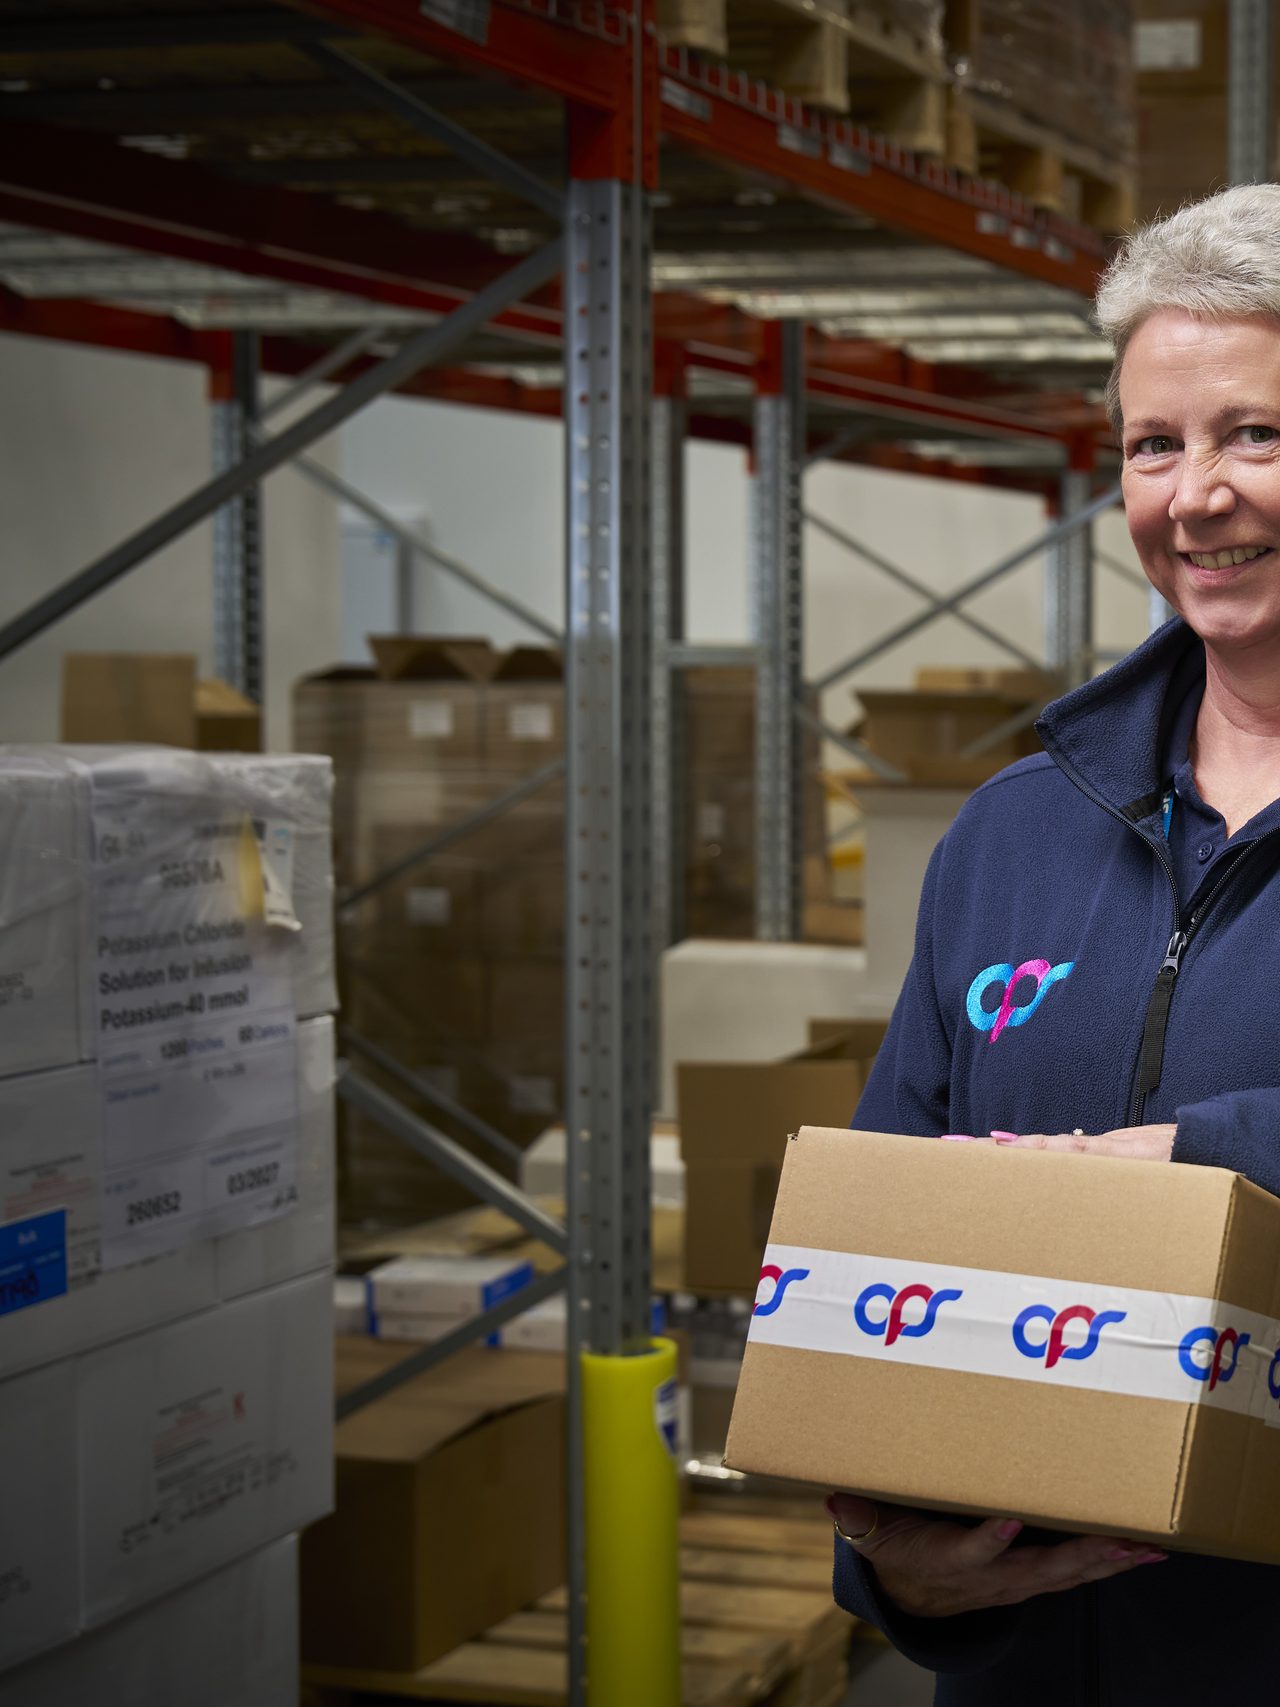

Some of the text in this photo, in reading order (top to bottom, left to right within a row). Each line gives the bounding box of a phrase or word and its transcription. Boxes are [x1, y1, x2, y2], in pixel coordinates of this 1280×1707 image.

[97, 919, 246, 958] Potassium Chloride
[99, 953, 253, 996] Solution for Infusion
[208, 983, 250, 1010] mmol
